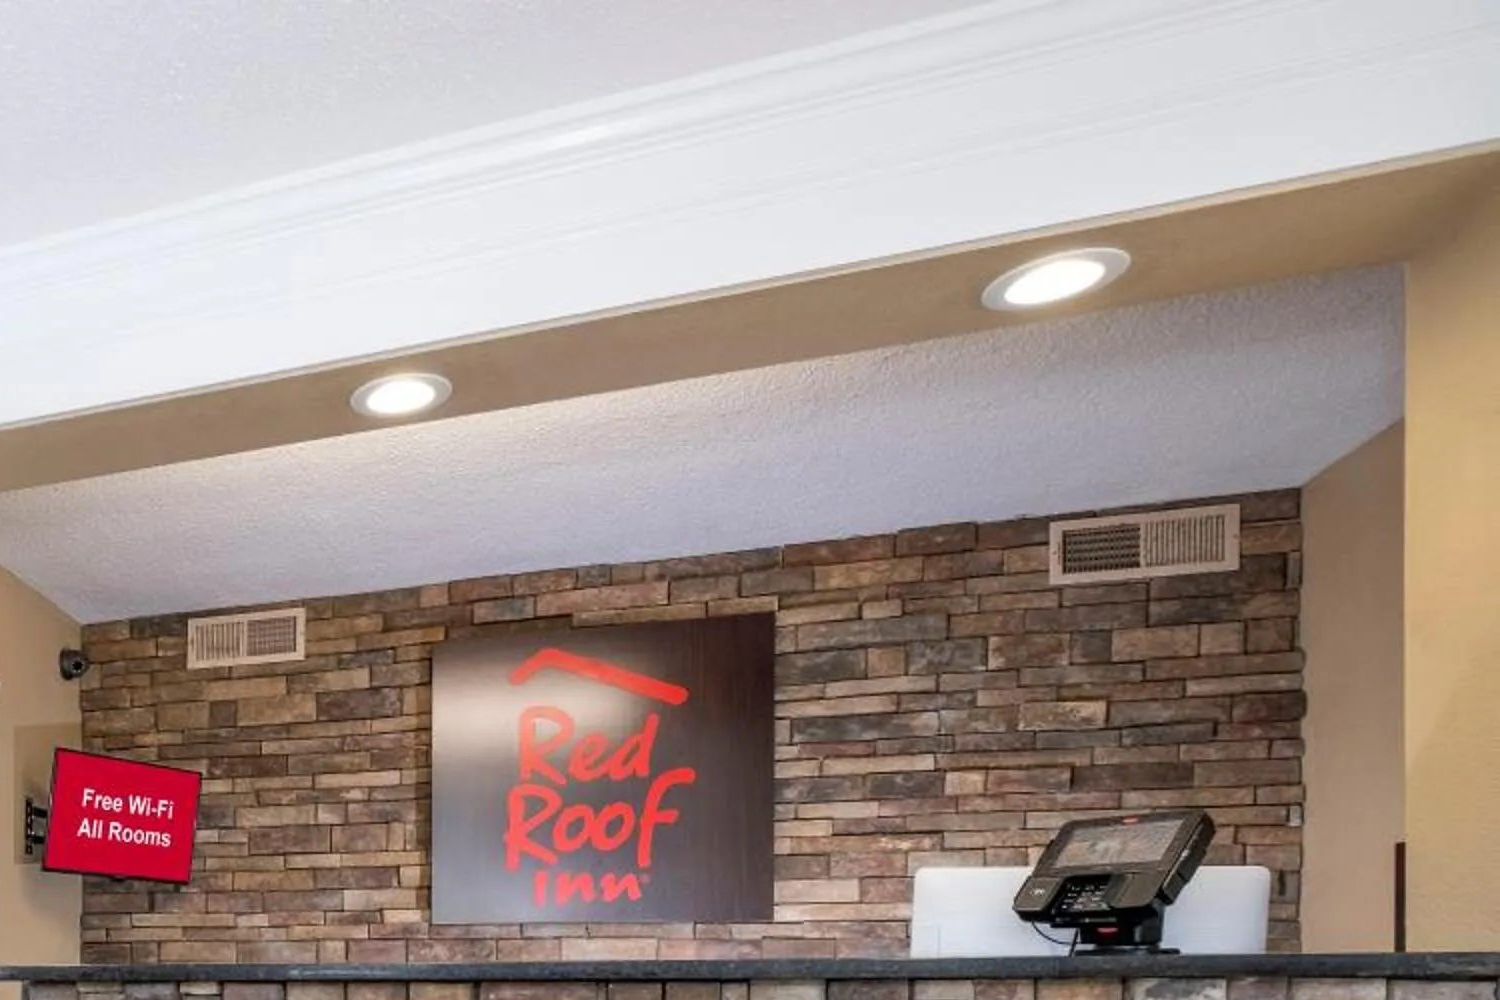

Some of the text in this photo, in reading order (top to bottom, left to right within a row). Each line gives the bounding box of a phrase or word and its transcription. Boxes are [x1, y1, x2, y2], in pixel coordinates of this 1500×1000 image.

[518, 706, 659, 785] Red
[82, 788, 174, 819] Free Wi-Fi
[504, 768, 696, 870] Roof
[77, 818, 171, 847] All Rooms
